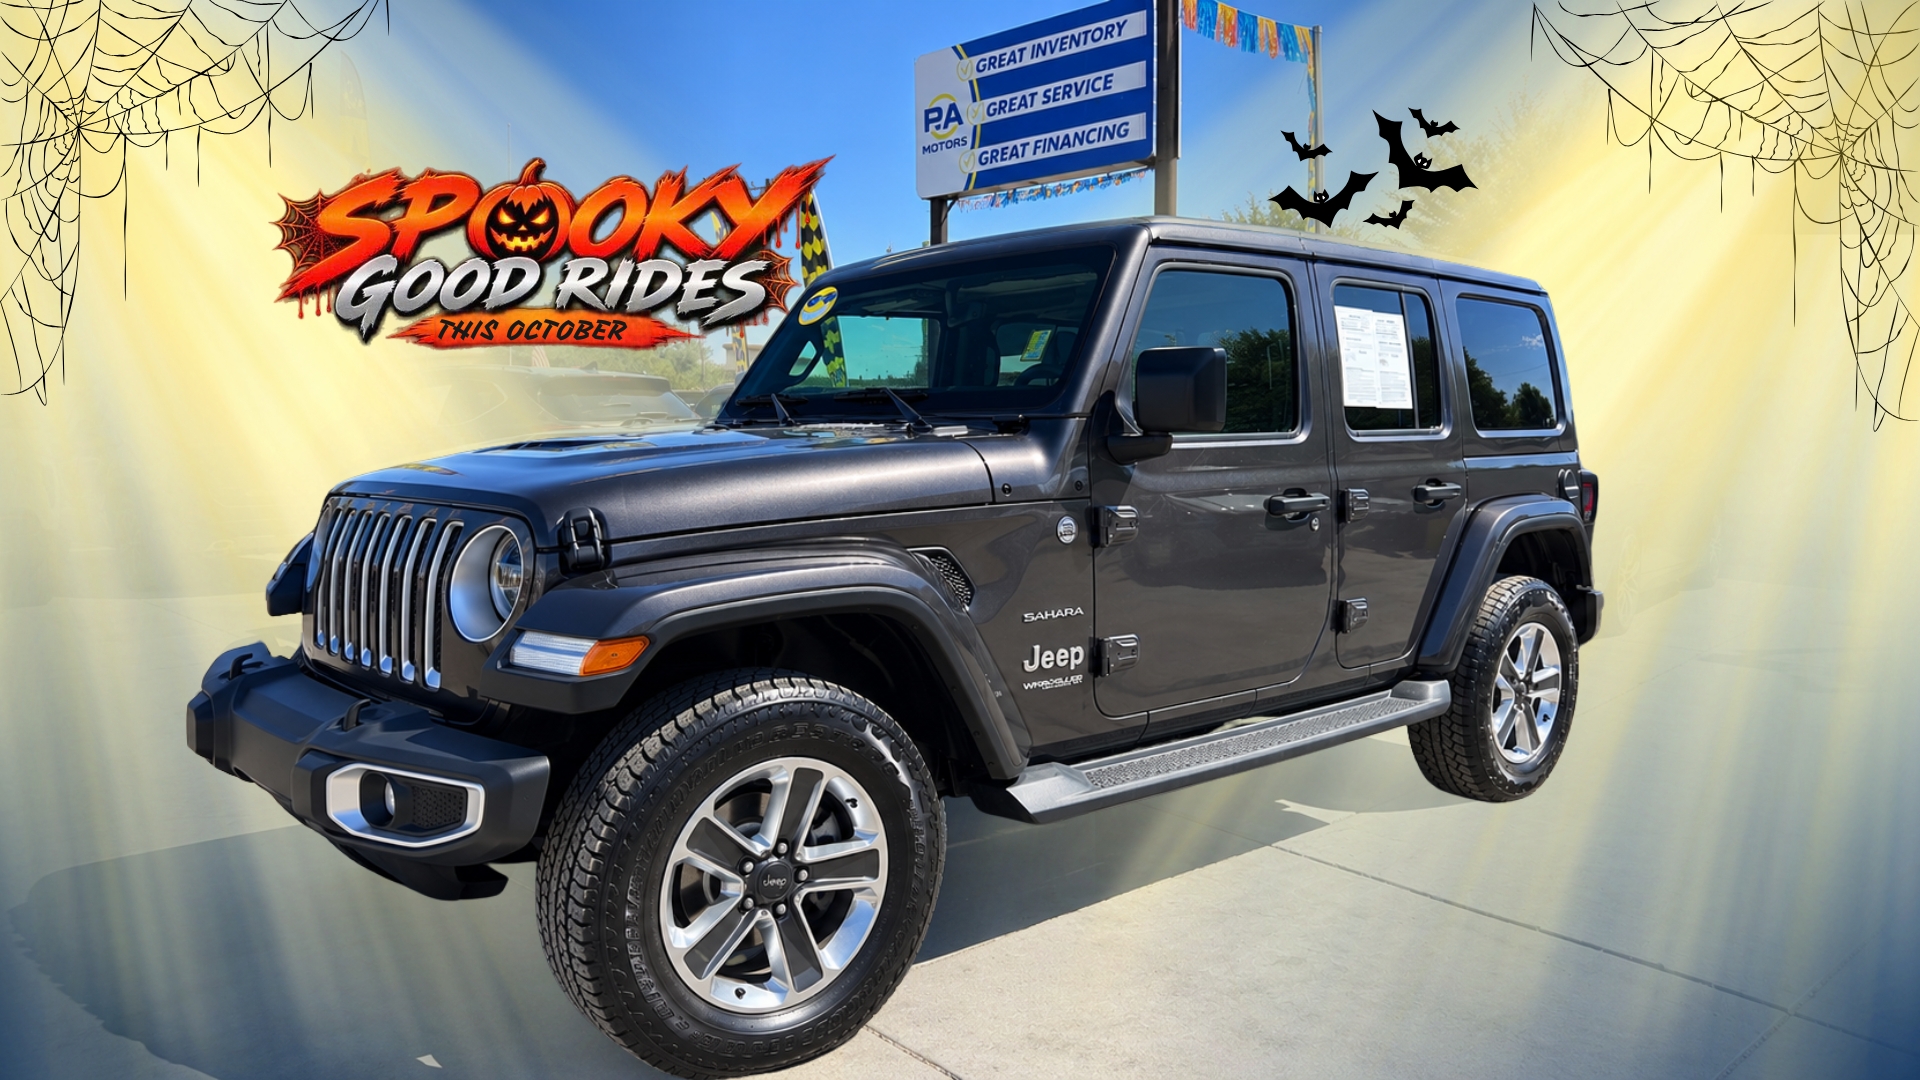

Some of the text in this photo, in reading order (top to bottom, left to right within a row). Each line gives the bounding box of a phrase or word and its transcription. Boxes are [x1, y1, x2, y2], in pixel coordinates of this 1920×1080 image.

[975, 19, 1128, 74] GREAT INVENTORY
[986, 73, 1115, 118] GREAT SERVICE
[922, 136, 968, 155] MOTORS
[978, 121, 1130, 166] GREAT FINANCING
[1023, 606, 1085, 623] SAHARA
[1023, 644, 1085, 672] Jeep
[762, 873, 787, 890] Jeep
